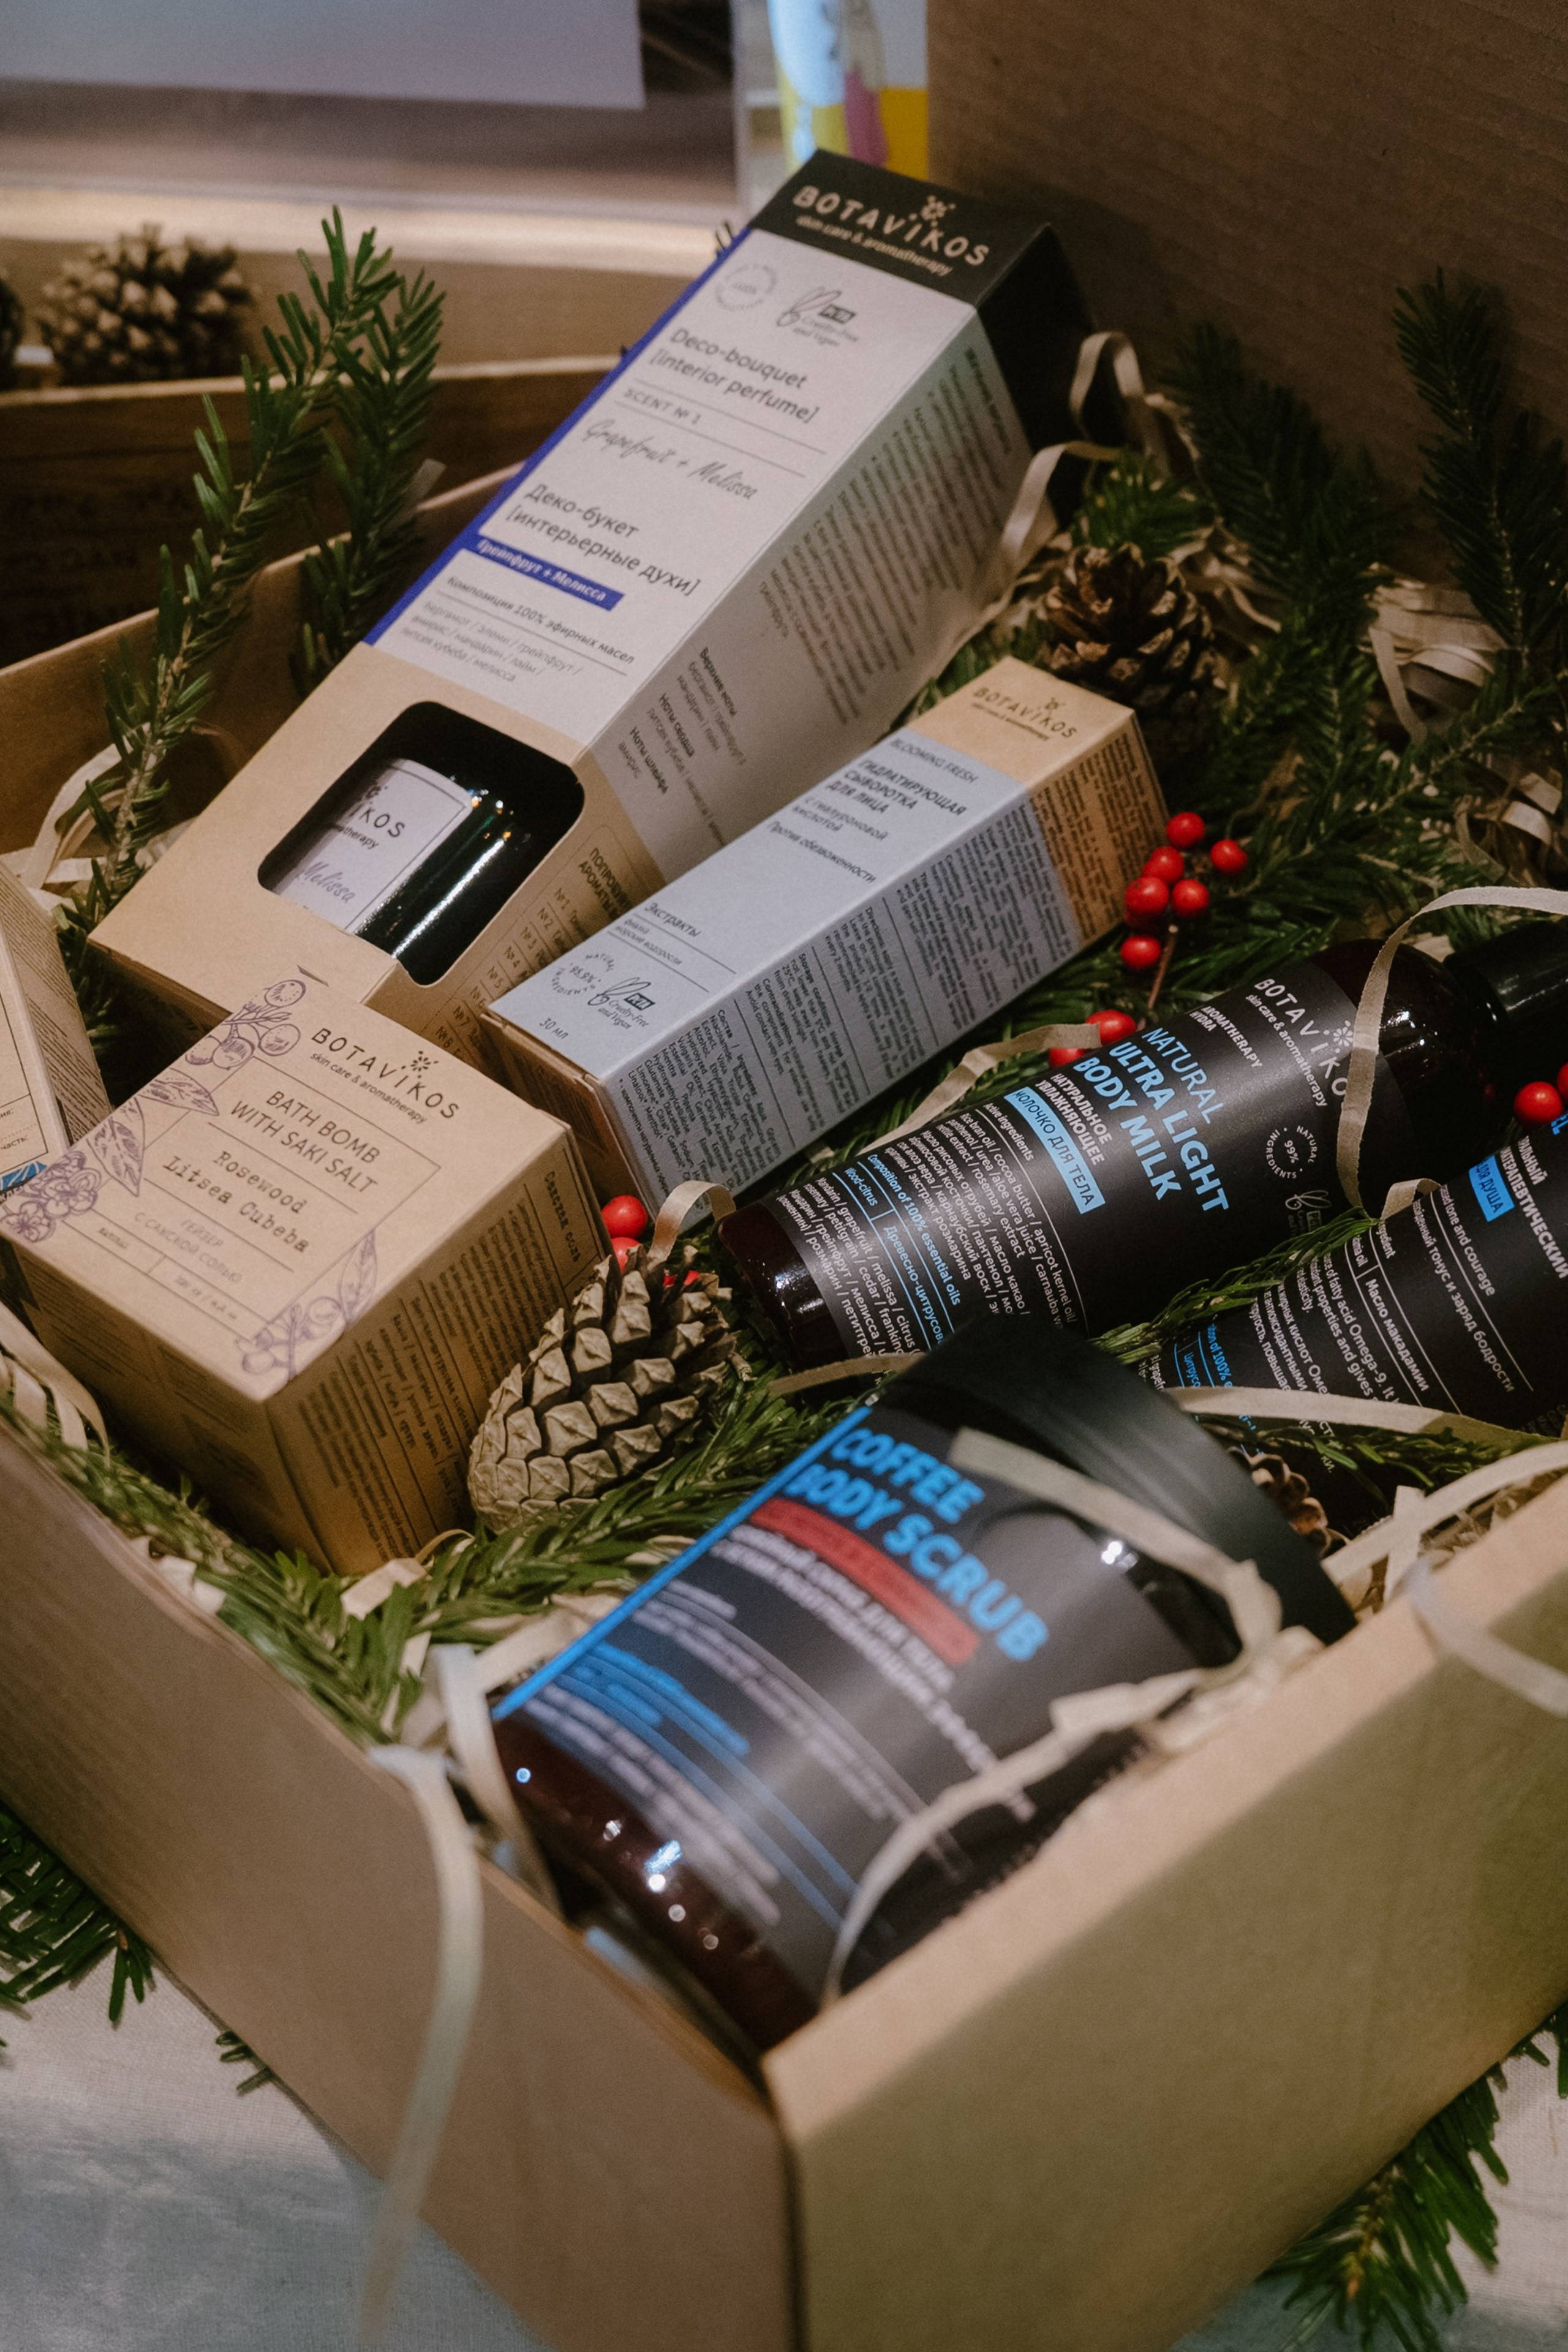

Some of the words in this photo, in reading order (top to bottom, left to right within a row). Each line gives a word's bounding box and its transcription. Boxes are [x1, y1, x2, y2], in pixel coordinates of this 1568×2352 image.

[793, 186, 989, 266] BOTAVIKOS
[624, 388, 673, 411] SCENT
[669, 327, 808, 390] Deco-bouquet
[723, 380, 820, 424] perfume]
[581, 418, 677, 464] Grapefruit
[687, 461, 758, 500] Melissa
[505, 503, 641, 571] [интерьерные
[638, 565, 701, 597] духи]
[523, 483, 639, 538] Деко-букет
[551, 571, 606, 601] Мелисса
[513, 605, 546, 625] 100%
[545, 620, 598, 647] эфирных
[597, 643, 635, 664] масел
[973, 687, 1077, 739] BOTAVIKOS
[644, 902, 701, 937] Экстракты
[539, 1017, 557, 1030] 30
[552, 1027, 569, 1039] мл
[1201, 1006, 1263, 1070] AROMATHERAPY
[1254, 979, 1352, 1096] BOTAVIKO
[1258, 1005, 1277, 1023] care
[1279, 1030, 1327, 1106] aromatherapy
[310, 1053, 331, 1067] skin
[330, 1064, 352, 1079] care
[359, 1080, 428, 1125] aromatherapy
[311, 1027, 459, 1119] BOTAVIKOS
[1050, 1073, 1114, 1145] НАТУРАЛЬНОЕ
[1142, 1028, 1227, 1126] NATURAL
[230, 1100, 285, 1137] WITH
[280, 1131, 328, 1164] SAKI
[325, 1158, 378, 1193] SALT
[265, 1090, 321, 1128] BATH
[317, 1120, 380, 1163] BOMB
[997, 1115, 1035, 1162] ingredients
[1012, 1090, 1056, 1134] МОЛОЧКО
[1047, 1136, 1075, 1164] ДЛЯ
[1069, 1164, 1095, 1206] ТЕЛА
[1035, 1080, 1105, 1167] УВЛАЖНЯЮЩЕЕ
[1073, 1057, 1139, 1117] BODY
[1119, 1113, 1182, 1200] MILK
[1109, 1041, 1177, 1111] ULTRA
[1160, 1109, 1229, 1211] LIGHT
[1265, 1129, 1298, 1178] INGREDIENTS
[1283, 1139, 1299, 1164] 99%
[1296, 1125, 1318, 1164] NATURAL
[162, 1155, 233, 1205] Litsea
[239, 1201, 309, 1253] Cubeba
[213, 1150, 307, 1215] Rosewood
[949, 1136, 974, 1163] extract
[972, 1168, 1005, 1215] rosemary
[998, 1216, 1025, 1258] extract
[969, 1121, 986, 1138] bran
[981, 1137, 996, 1148] oil
[993, 1153, 1018, 1185] cocoa
[1011, 1183, 1035, 1218] butter
[1031, 1228, 1059, 1270] apricot
[1052, 1269, 1071, 1306] kernel
[1478, 1178, 1504, 1213] ДУША
[806, 1237, 842, 1290] розмарин
[825, 1212, 860, 1259] petitgrain
[857, 1264, 880, 1298] cedar
[897, 1192, 912, 1203] of
[905, 1202, 929, 1232] 100%
[919, 1231, 952, 1283] essential
[946, 1283, 960, 1306] oils
[908, 1173, 940, 1216] экстракт
[932, 1215, 971, 1280] розмарина
[917, 1164, 936, 1185] вера
[935, 1190, 980, 1262] карнаубский
[973, 1263, 991, 1293] воск
[933, 1145, 965, 1182] рисовых
[960, 1182, 992, 1227] отрубей
[989, 1235, 1011, 1273] масло
[1006, 1275, 1025, 1309] какао
[942, 1176, 980, 1228] косточки/
[971, 1229, 1003, 1287] пантенол
[976, 1150, 994, 1172] urea
[989, 1172, 1010, 1199] /aloe
[1003, 1198, 1023, 1225] vera
[1015, 1224, 1036, 1254] juice
[1035, 1263, 1058, 1314] carnauba
[1429, 1246, 1451, 1283] тонус
[1445, 1203, 1460, 1226] tone
[1453, 1224, 1472, 1246] and
[1464, 1246, 1495, 1296] courage
[815, 1223, 852, 1278] грейпфрут
[850, 1287, 880, 1340] мелисса
[837, 1207, 875, 1255] grapefruit
[870, 1261, 897, 1306] melissa
[896, 1314, 916, 1348] citrus
[881, 1223, 943, 1340] Древесно-цитрусов
[1446, 1281, 1457, 1292] и
[1451, 1292, 1477, 1332] заряд
[1264, 1297, 1308, 1391] антиоксидантными
[1289, 1324, 1313, 1364] кислот
[1312, 1284, 1343, 1338] properties
[1336, 1337, 1357, 1362] and
[1347, 1362, 1373, 1396] gives
[1329, 1276, 1344, 1300] fatty
[1337, 1300, 1357, 1325] acid
[1349, 1323, 1387, 1387] Omega-9.
[1355, 1254, 1368, 1267] oil
[1365, 1278, 1389, 1318] Масло
[1383, 1318, 1429, 1391] макадамии
[1473, 1329, 1514, 1392] бодрости
[1212, 1351, 1232, 1381] 100%
[831, 1428, 984, 1524] COFFEE
[884, 1513, 1050, 1662] SCRUB
